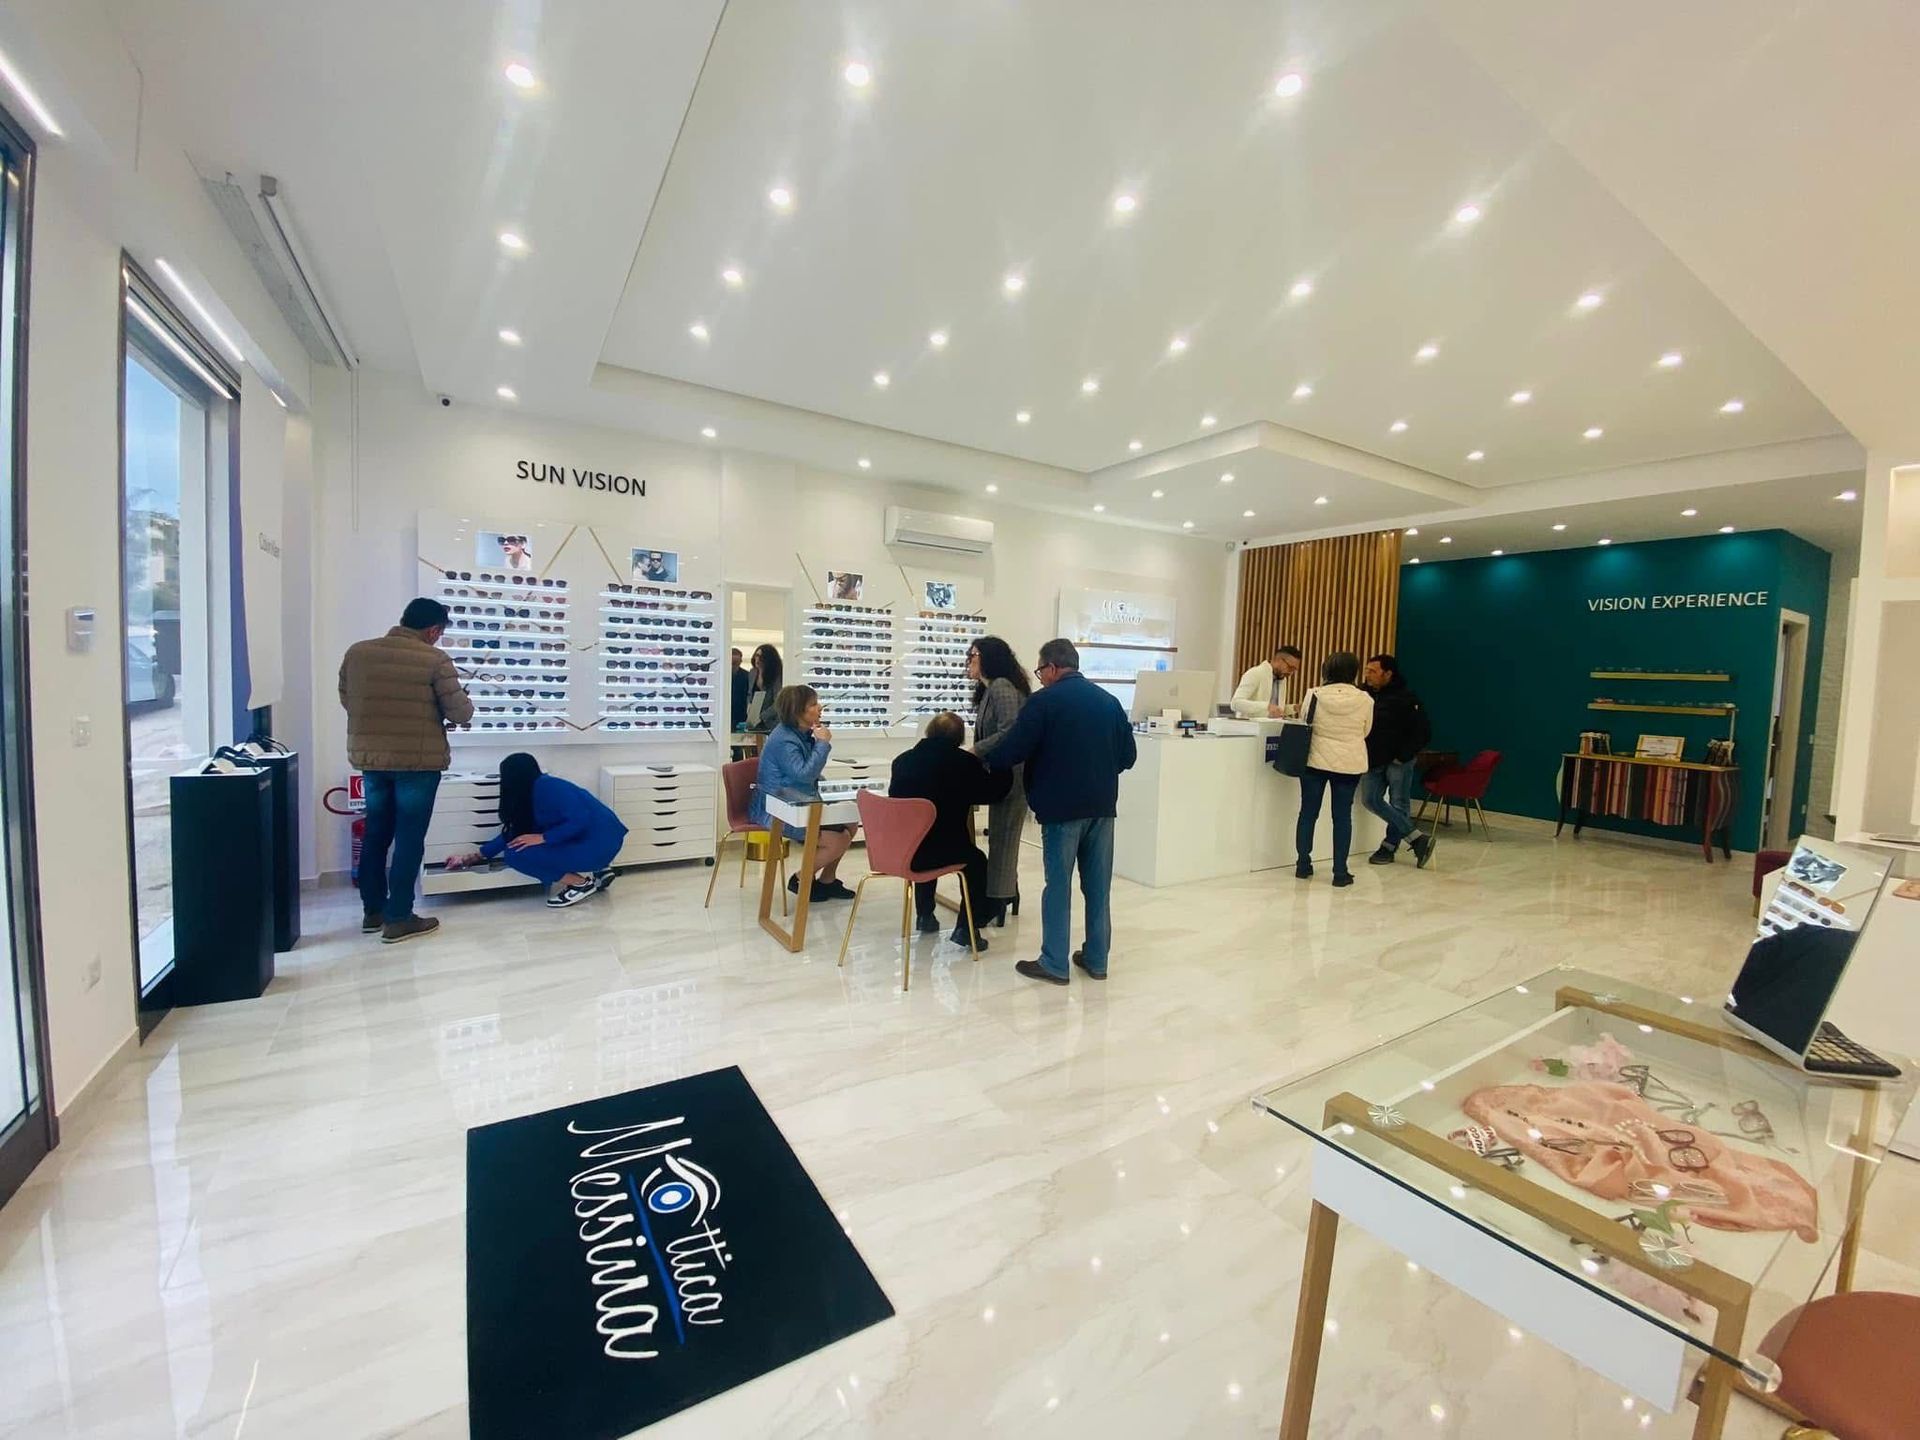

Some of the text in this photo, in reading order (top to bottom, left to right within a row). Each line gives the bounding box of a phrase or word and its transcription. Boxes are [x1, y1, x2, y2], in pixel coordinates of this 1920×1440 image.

[516, 460, 645, 497] SUN VISION
[1588, 591, 1769, 611] VISION EXPERIENCE
[1469, 1126, 1485, 1155] HUGO
[567, 1116, 692, 1359] Messina
